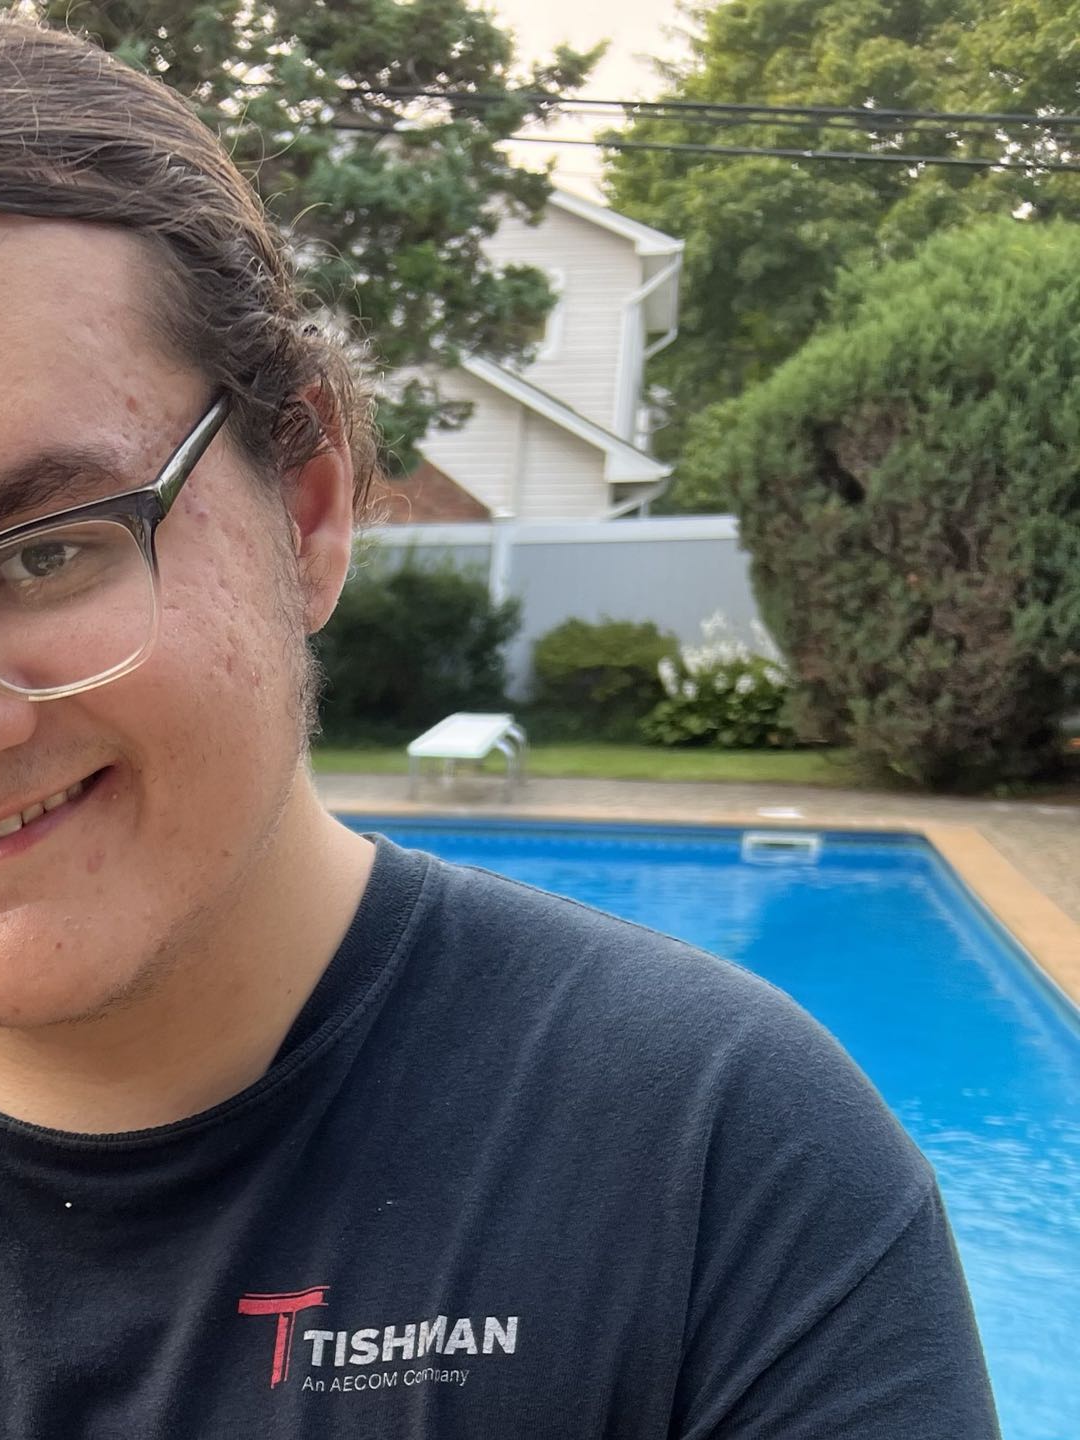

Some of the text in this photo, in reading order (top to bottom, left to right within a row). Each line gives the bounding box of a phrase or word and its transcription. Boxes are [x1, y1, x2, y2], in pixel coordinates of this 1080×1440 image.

[303, 1315, 519, 1367] TISHMAN
[301, 1367, 470, 1392] An AECOM Company
